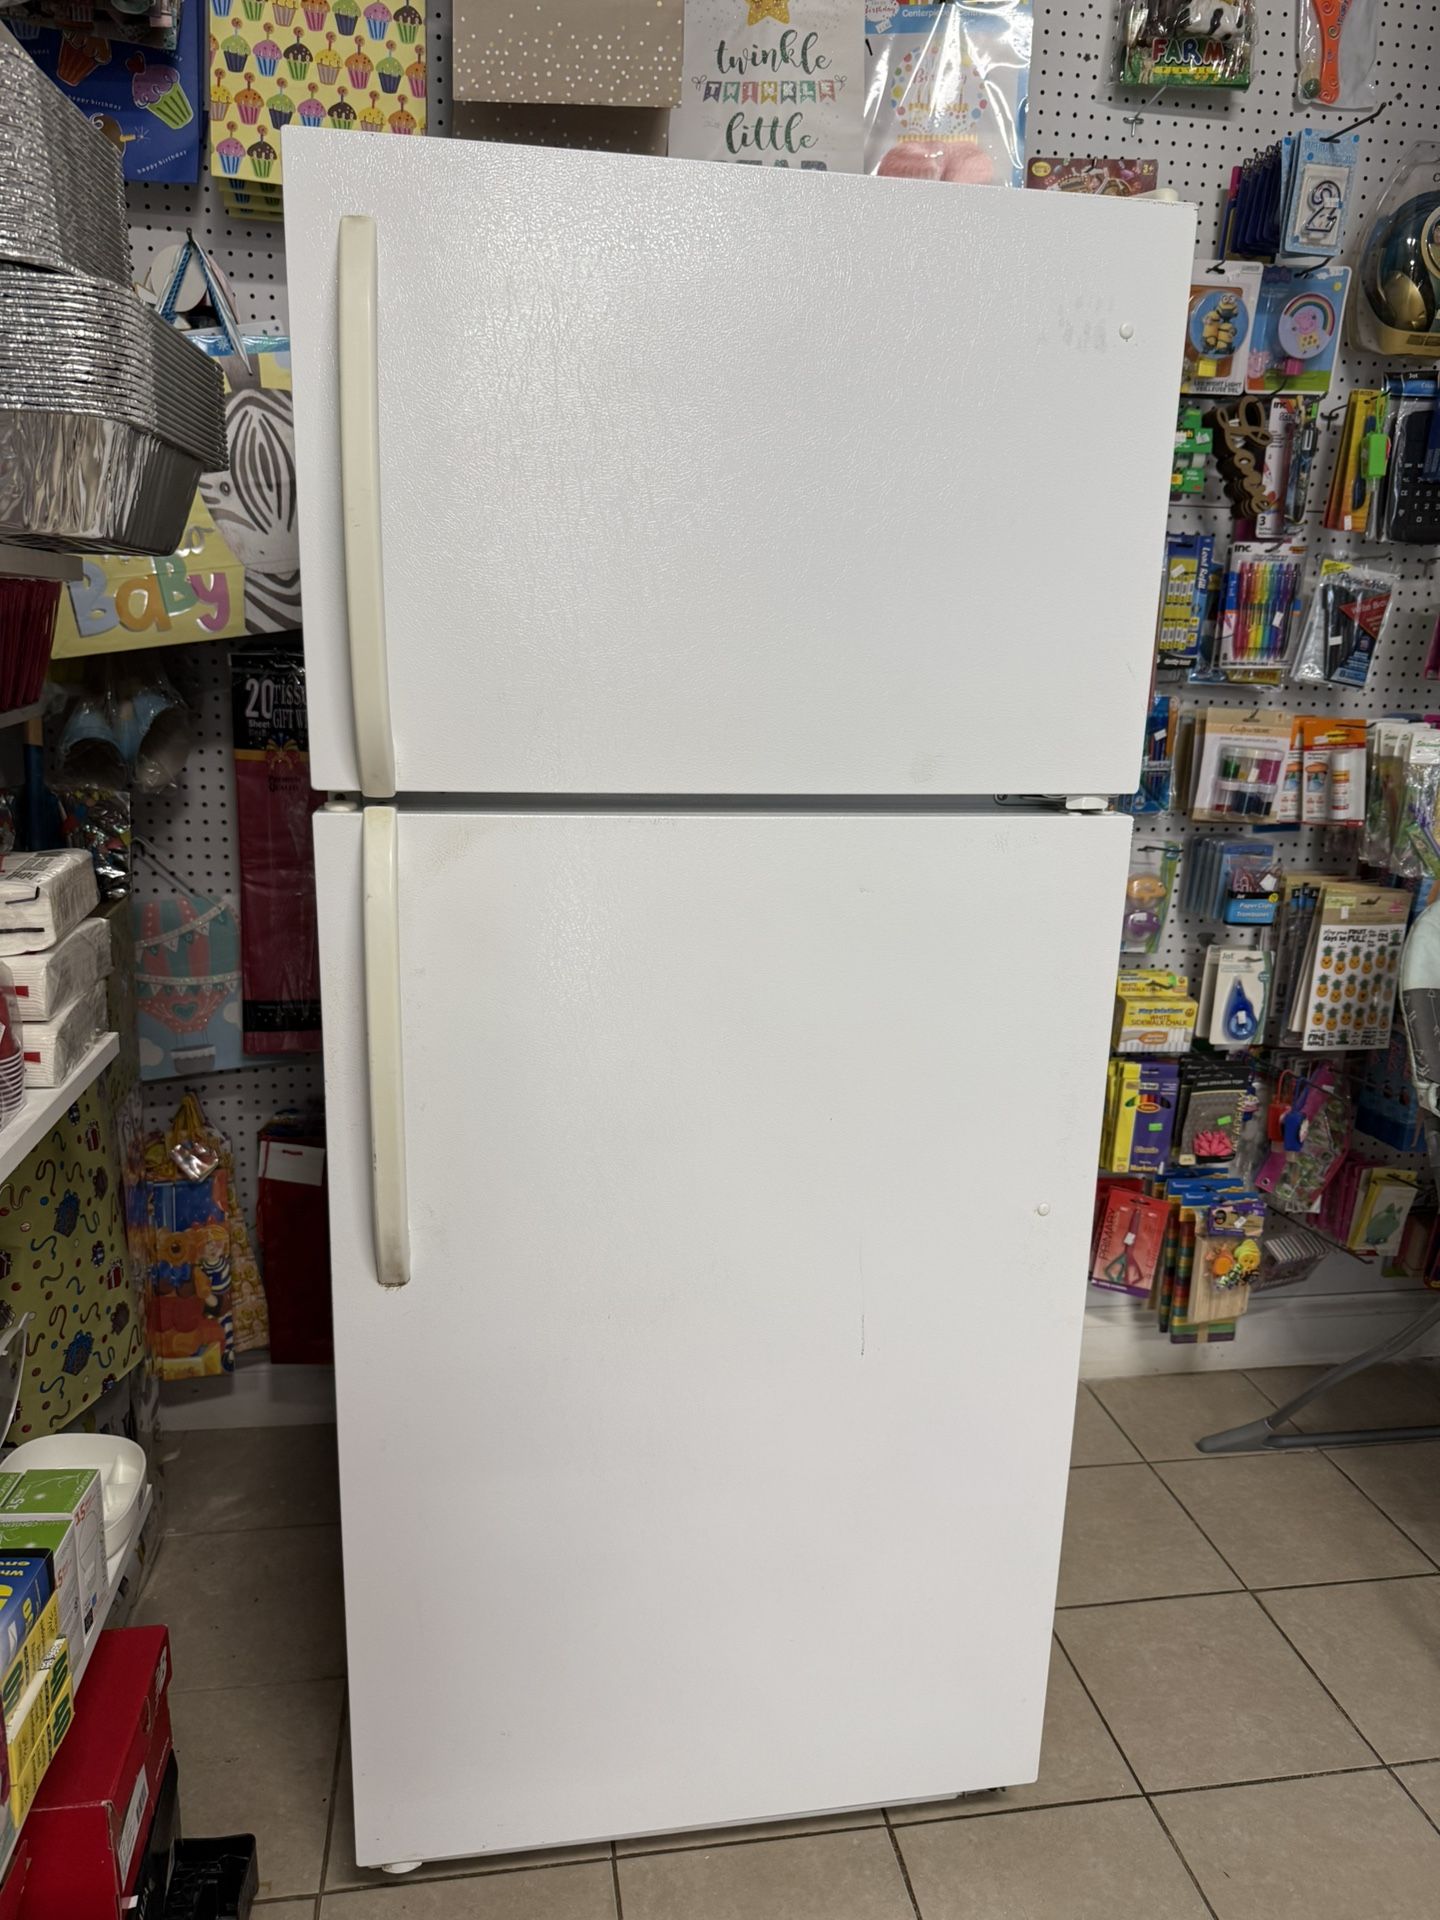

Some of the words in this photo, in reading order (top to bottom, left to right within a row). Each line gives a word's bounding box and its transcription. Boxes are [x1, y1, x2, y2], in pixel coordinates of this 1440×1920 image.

[714, 29, 833, 75] twinkle
[1152, 38, 1225, 65] FARM
[707, 80, 833, 97] TWINKLE
[725, 112, 819, 154] little
[245, 677, 274, 719] 20
[272, 708, 294, 729] GIFT
[1098, 1207, 1116, 1260] PRIMARY
[6, 1497, 25, 1511] 15
